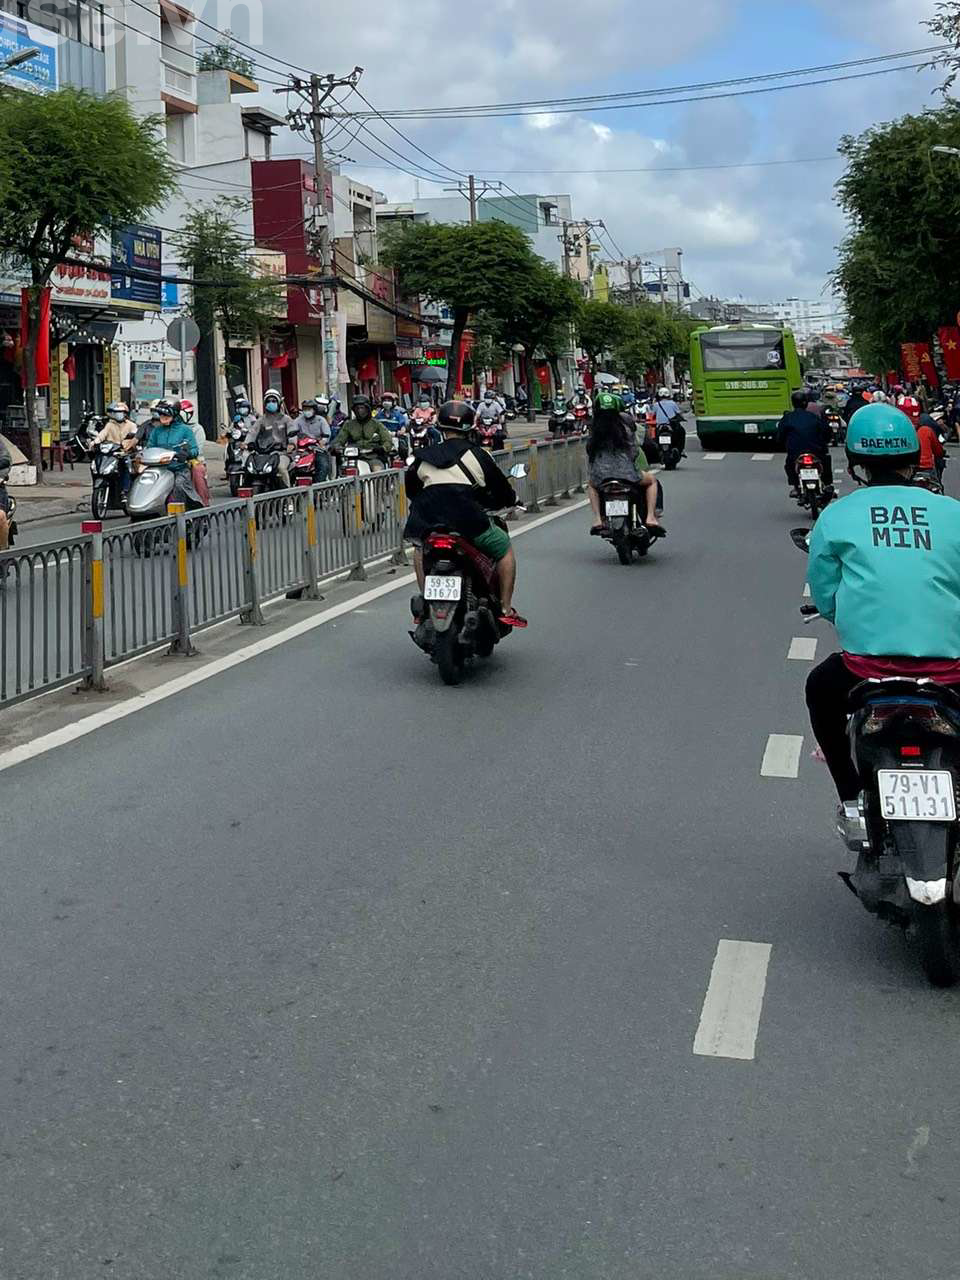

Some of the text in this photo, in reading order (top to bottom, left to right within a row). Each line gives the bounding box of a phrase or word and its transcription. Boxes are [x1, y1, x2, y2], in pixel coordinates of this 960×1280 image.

[860, 438, 907, 448] BAEMIN
[870, 506, 929, 526] BAE
[872, 527, 931, 550] MIN
[889, 774, 939, 794] 79-V1
[885, 796, 948, 816] 511.31
